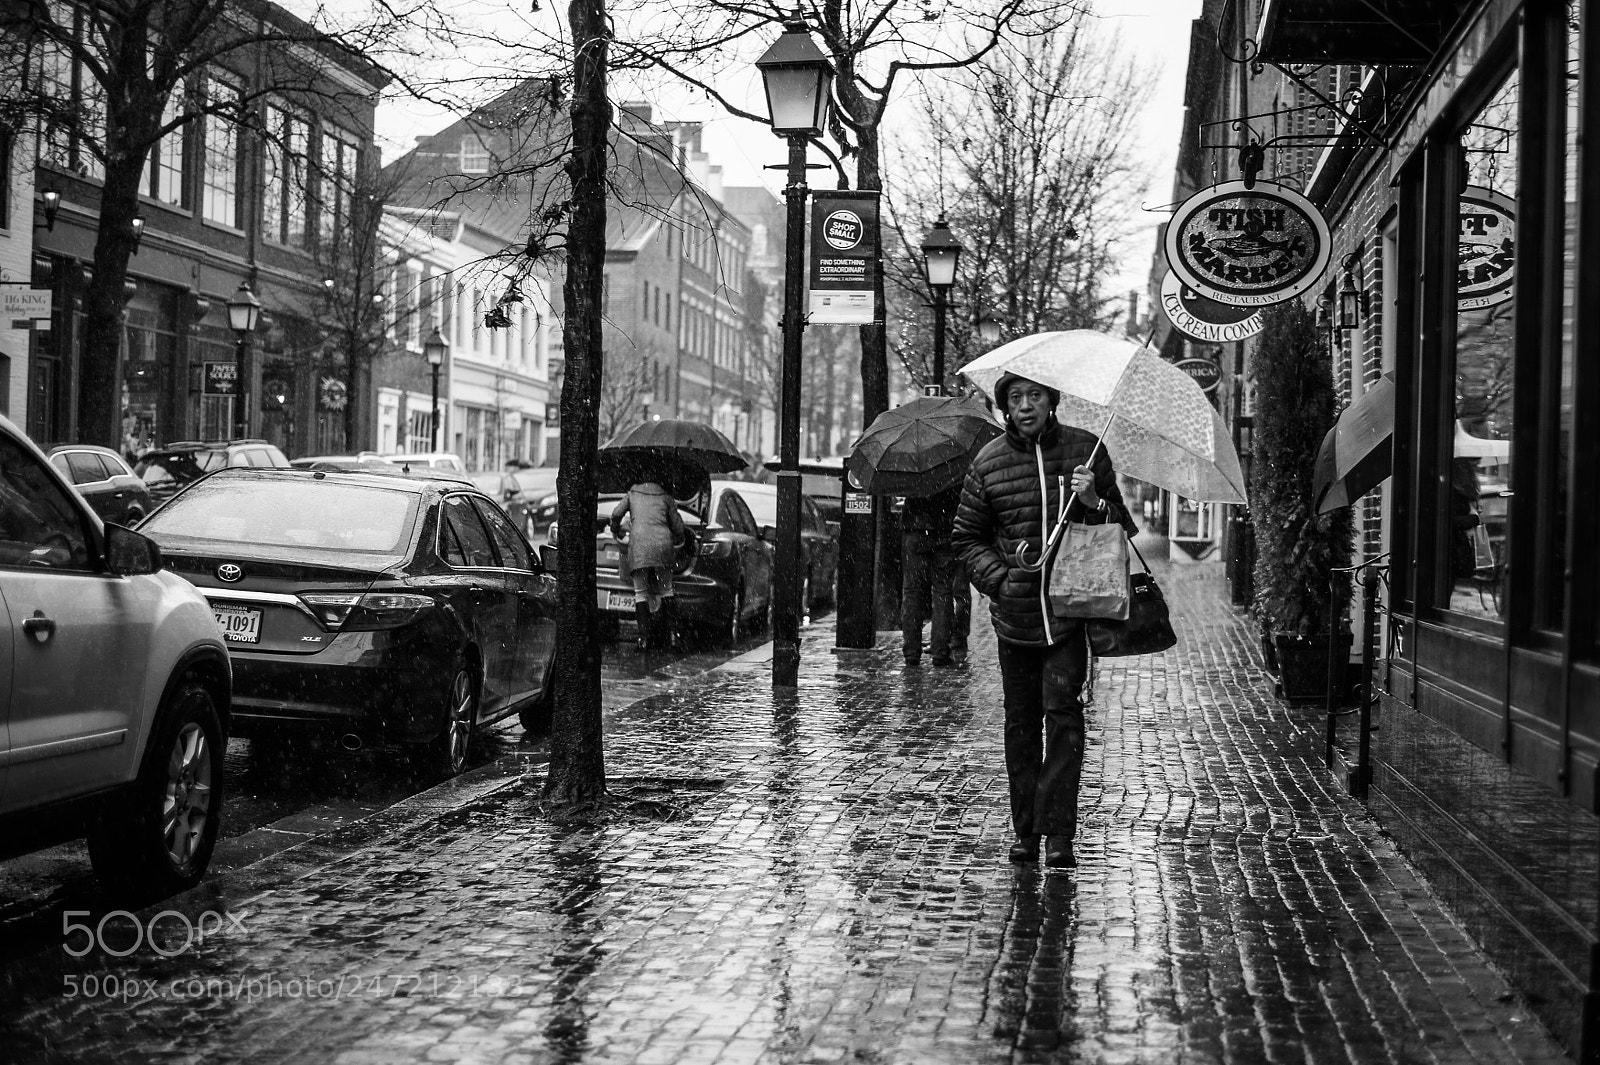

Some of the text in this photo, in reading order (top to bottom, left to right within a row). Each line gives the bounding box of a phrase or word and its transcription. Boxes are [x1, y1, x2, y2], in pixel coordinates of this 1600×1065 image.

[832, 221, 856, 232] SHOP
[1208, 208, 1285, 233] FISH
[829, 227, 856, 240] SMALL
[1189, 231, 1307, 284] MARKET
[4, 294, 47, 304] 116 KING
[1212, 291, 1282, 305] RESTAURANT
[1164, 292, 1183, 317] ICE
[1177, 311, 1220, 340] CREAM
[848, 501, 869, 510] 11502
[229, 634, 256, 643] TOYOTA
